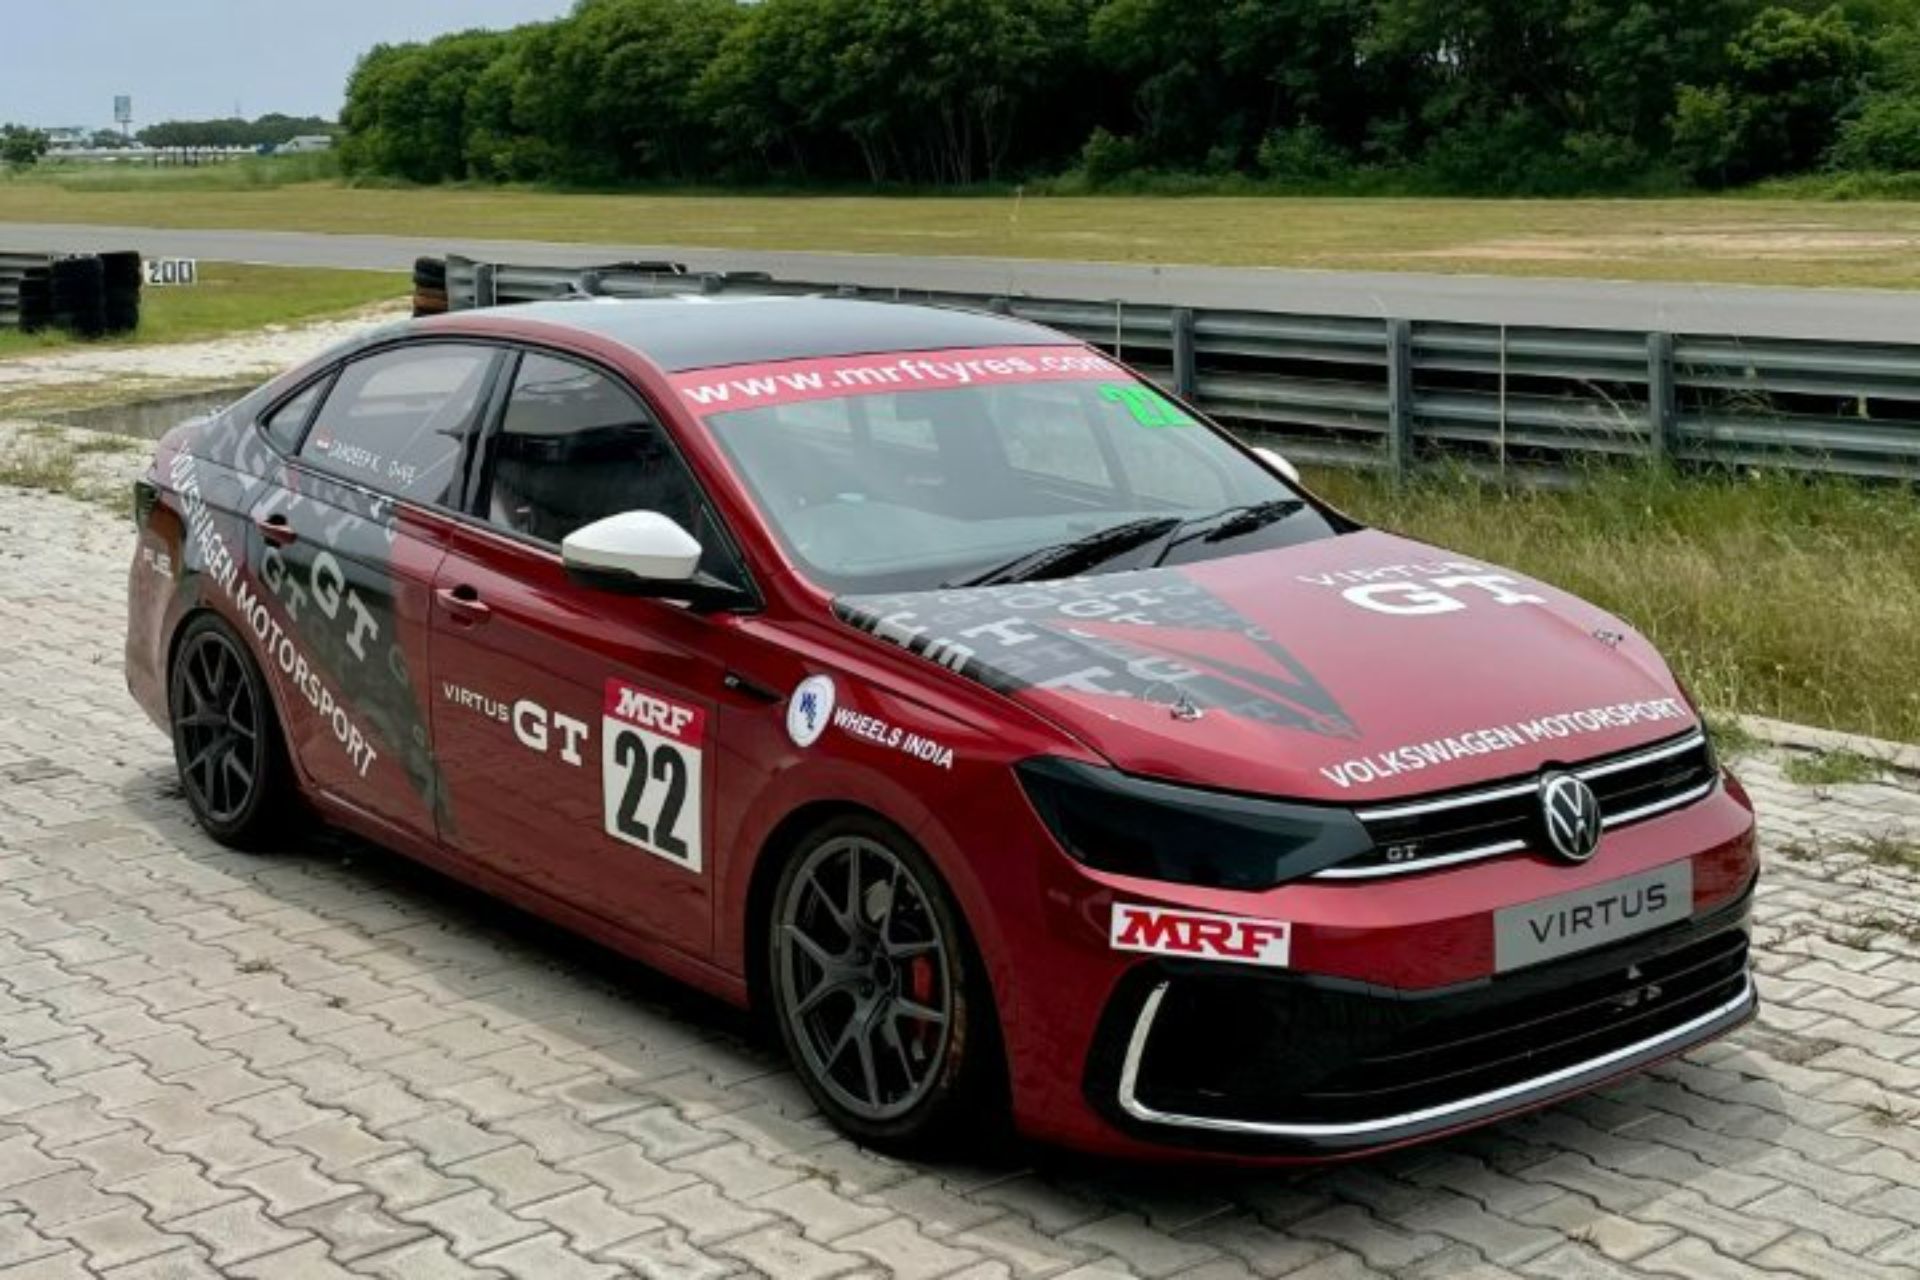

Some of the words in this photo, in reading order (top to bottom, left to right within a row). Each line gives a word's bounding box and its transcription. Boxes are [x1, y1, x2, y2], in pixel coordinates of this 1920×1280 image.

[147, 260, 193, 284] 200
[682, 356, 1113, 404] www.mrftyres.com
[311, 551, 379, 662] GT
[1341, 575, 1548, 614] GT
[237, 581, 377, 778] MOTORSPORT
[442, 682, 509, 722] VIRTUS
[513, 699, 588, 767] GT
[615, 687, 693, 735] MRF
[834, 706, 903, 747] WHEELS
[902, 732, 954, 770] INDIA
[1319, 727, 1524, 788] VOLKSWAGEN
[1520, 698, 1686, 743] MOTORSPORT
[615, 730, 688, 859] 22
[1386, 845, 1417, 861] GT
[1116, 908, 1284, 959] MRF
[1529, 884, 1668, 943] VIRTUS
